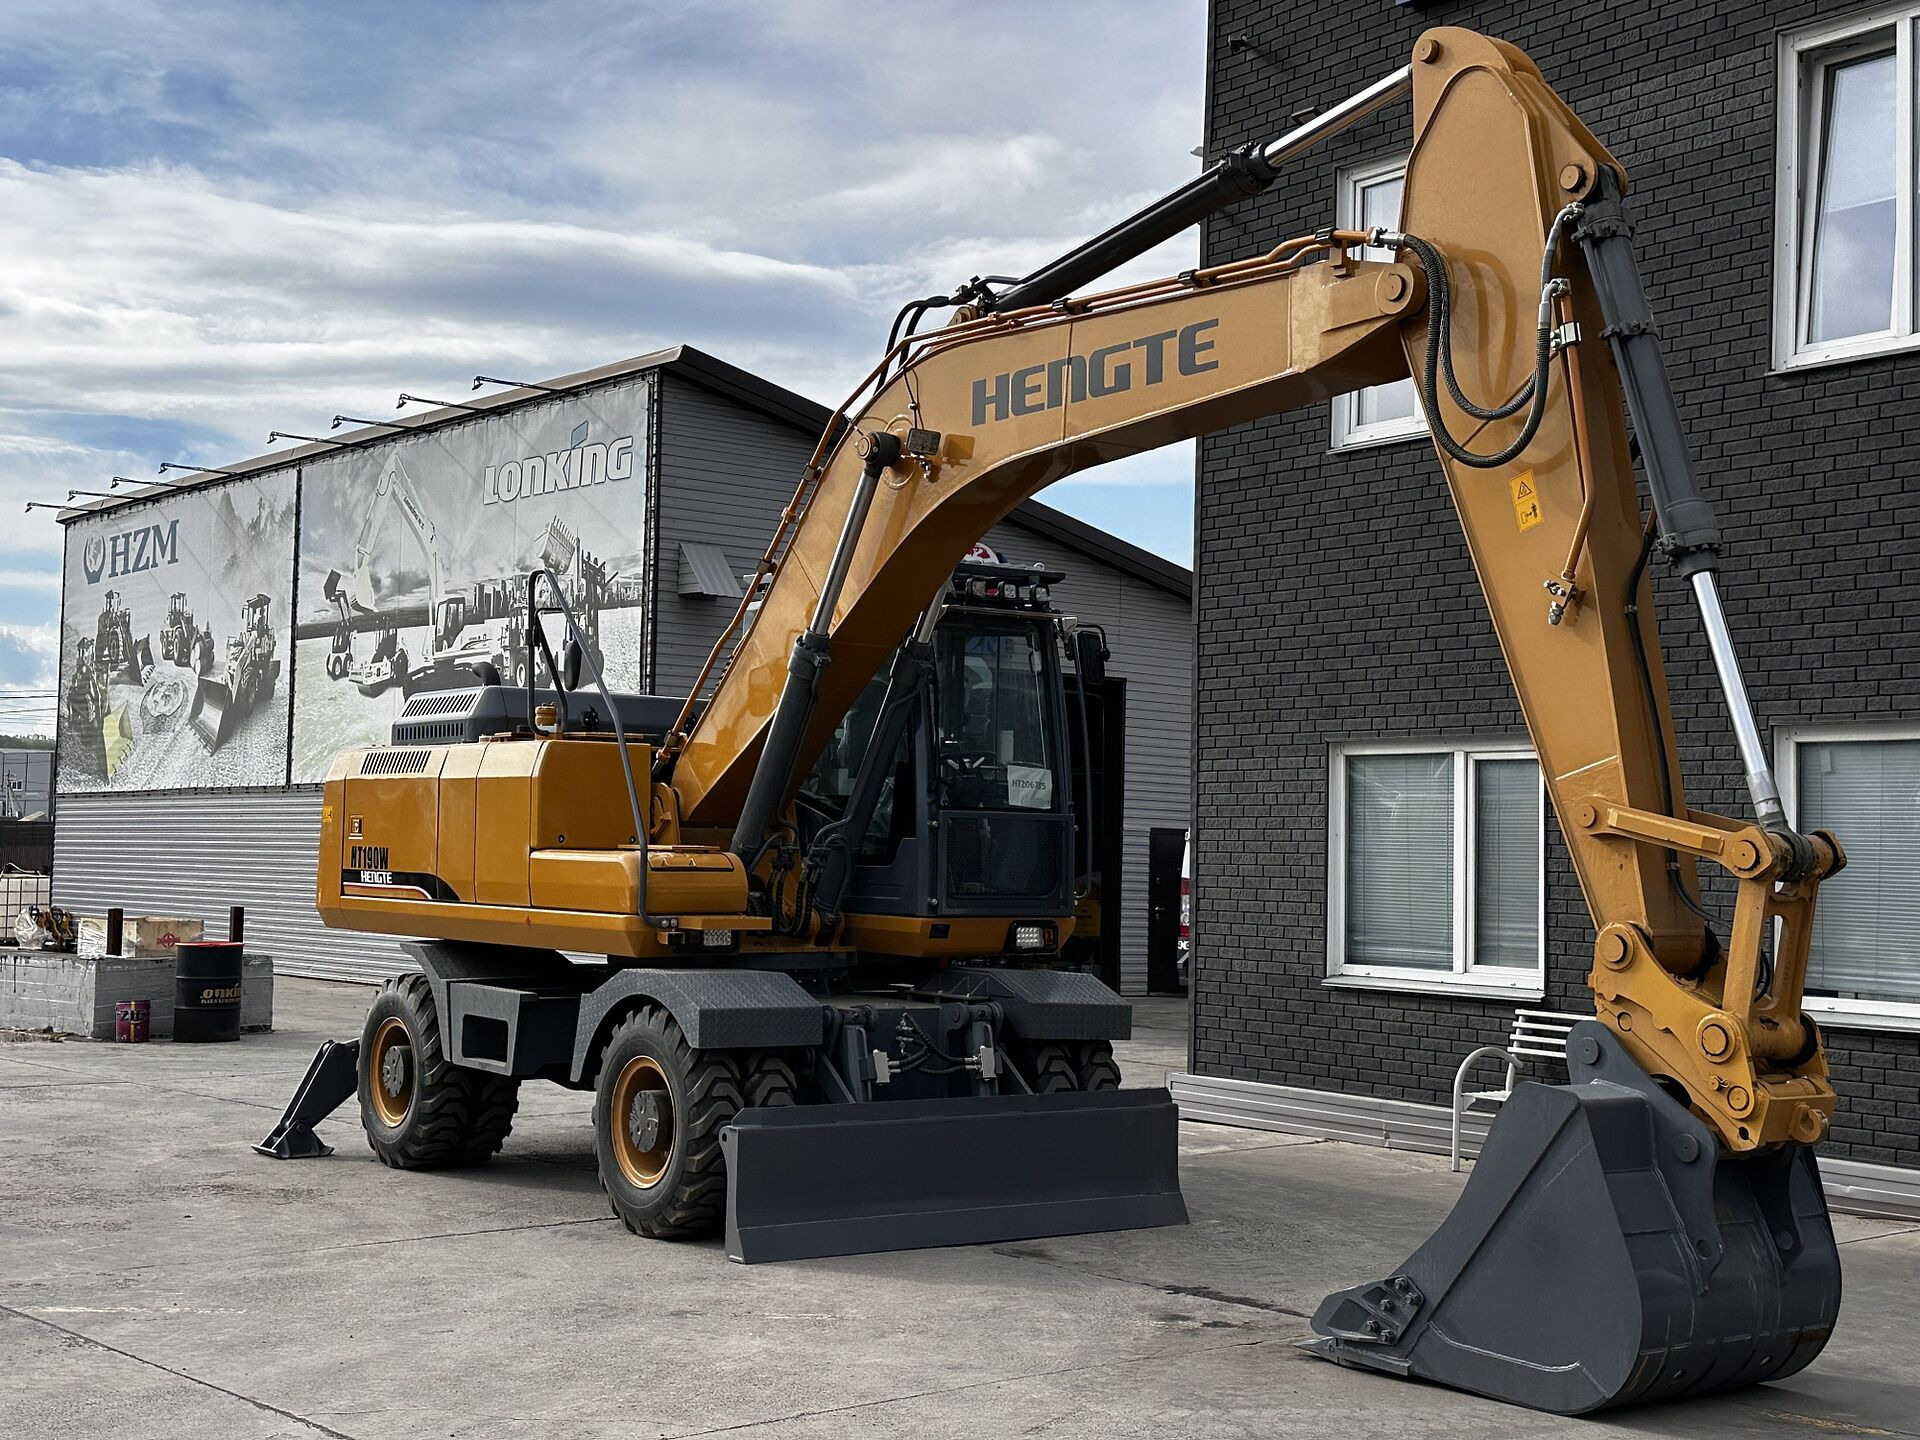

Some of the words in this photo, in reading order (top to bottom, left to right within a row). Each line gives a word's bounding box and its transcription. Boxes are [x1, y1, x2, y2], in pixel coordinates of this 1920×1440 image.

[972, 318, 1219, 427] HENGTE
[483, 420, 634, 505] LONKING
[108, 519, 180, 578] HZM
[350, 846, 389, 869] HT190W
[360, 870, 393, 884] HENGTE
